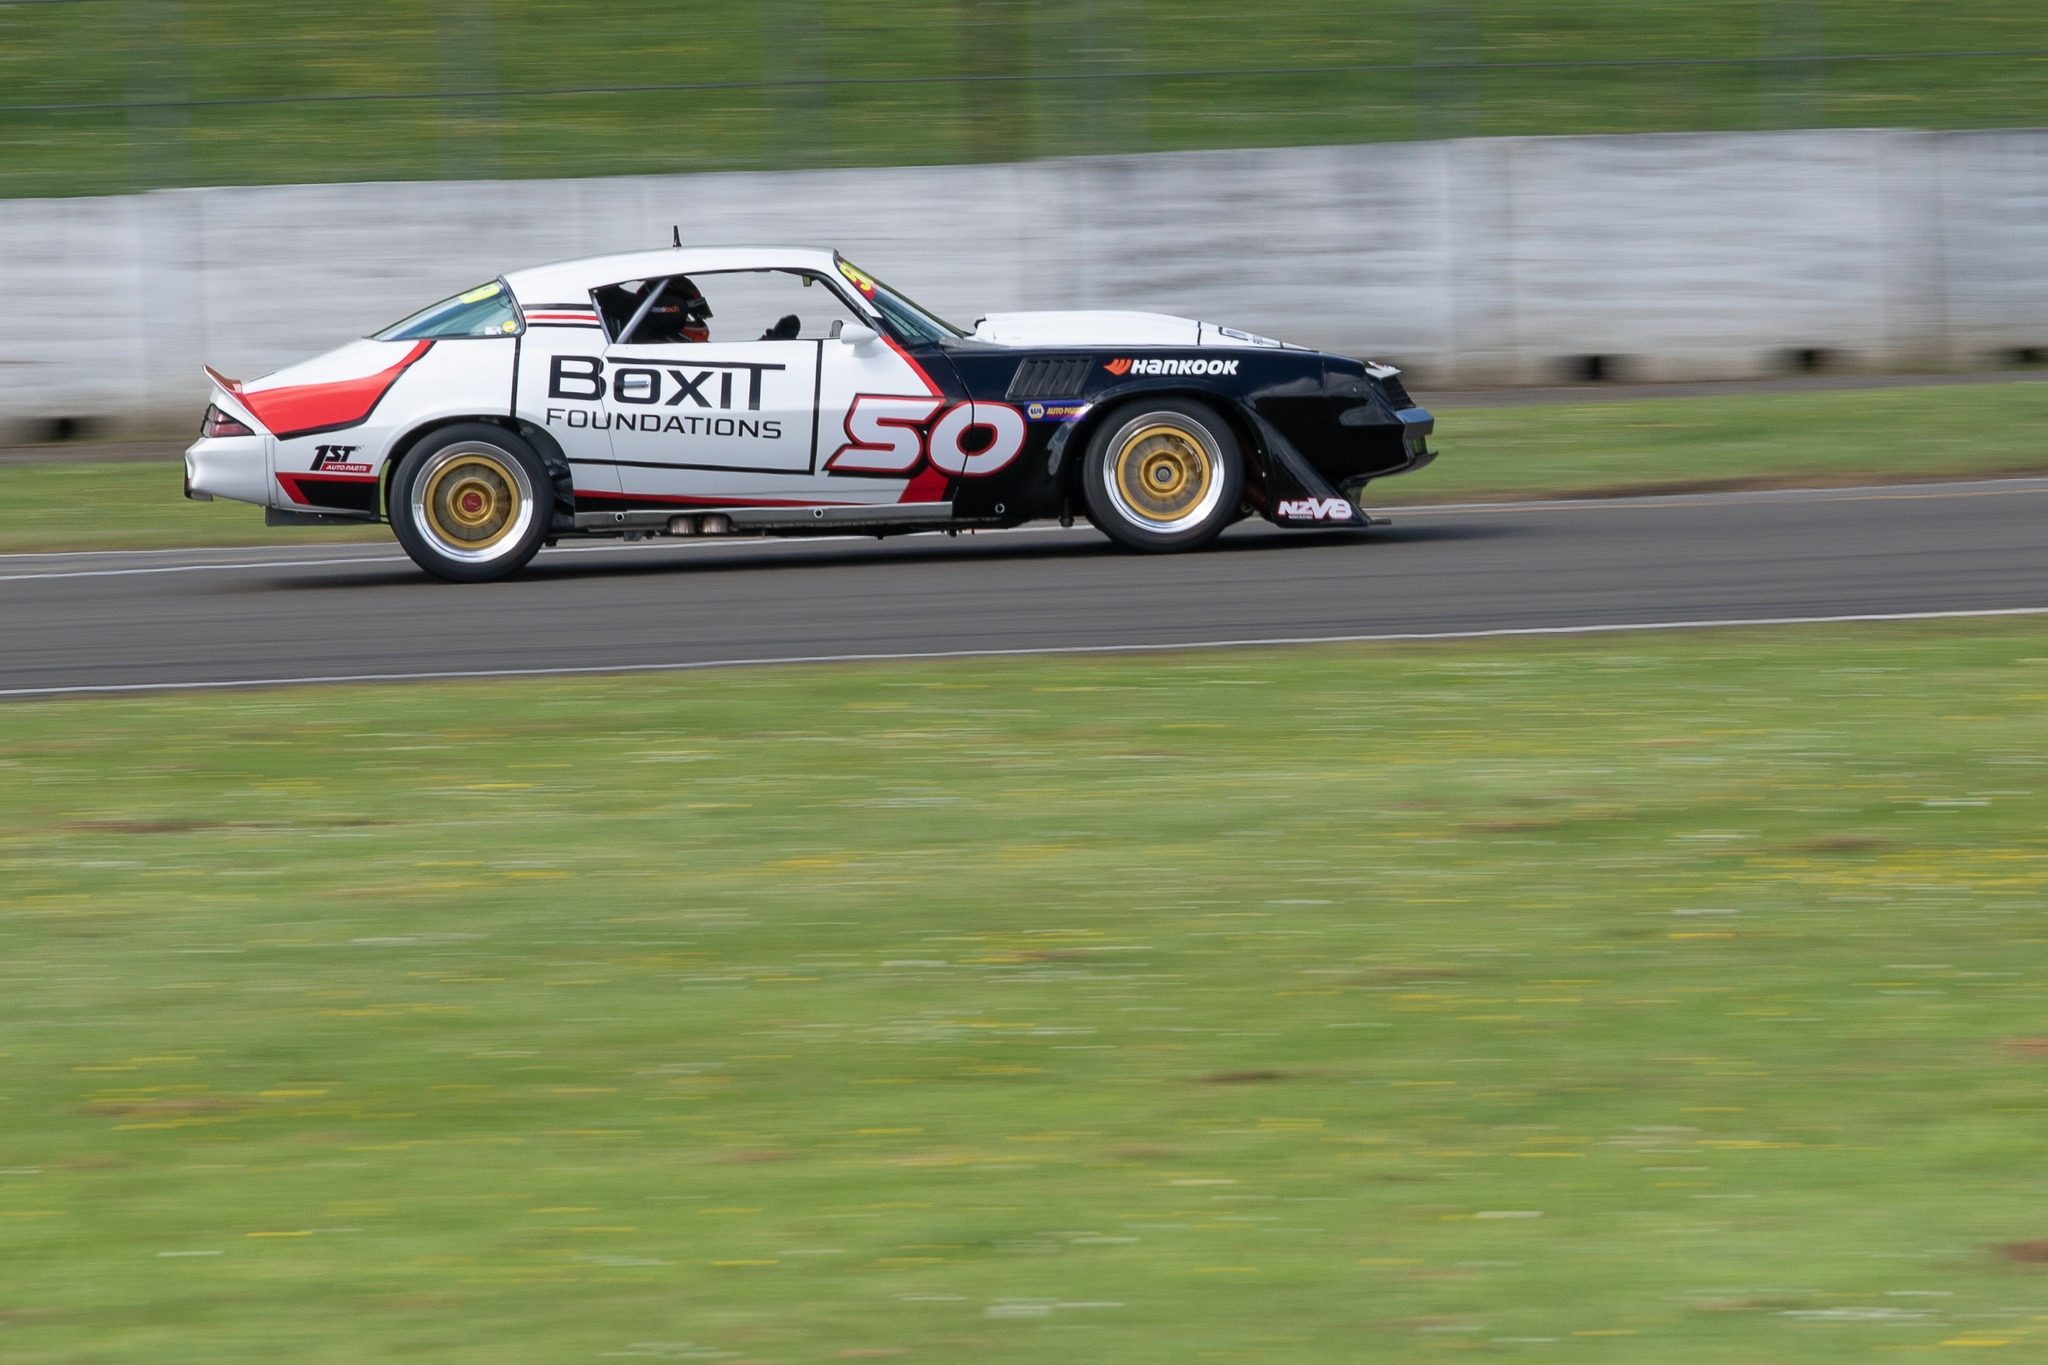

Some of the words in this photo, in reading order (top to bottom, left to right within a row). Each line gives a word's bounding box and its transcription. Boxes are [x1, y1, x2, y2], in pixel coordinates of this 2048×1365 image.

[546, 408, 782, 439] FOUNDATIONS
[1046, 407, 1063, 416] AUTO
[821, 393, 1027, 479] 50
[309, 444, 358, 471] 1ST
[346, 464, 367, 472] PARTS
[1278, 497, 1353, 519] NZV8
